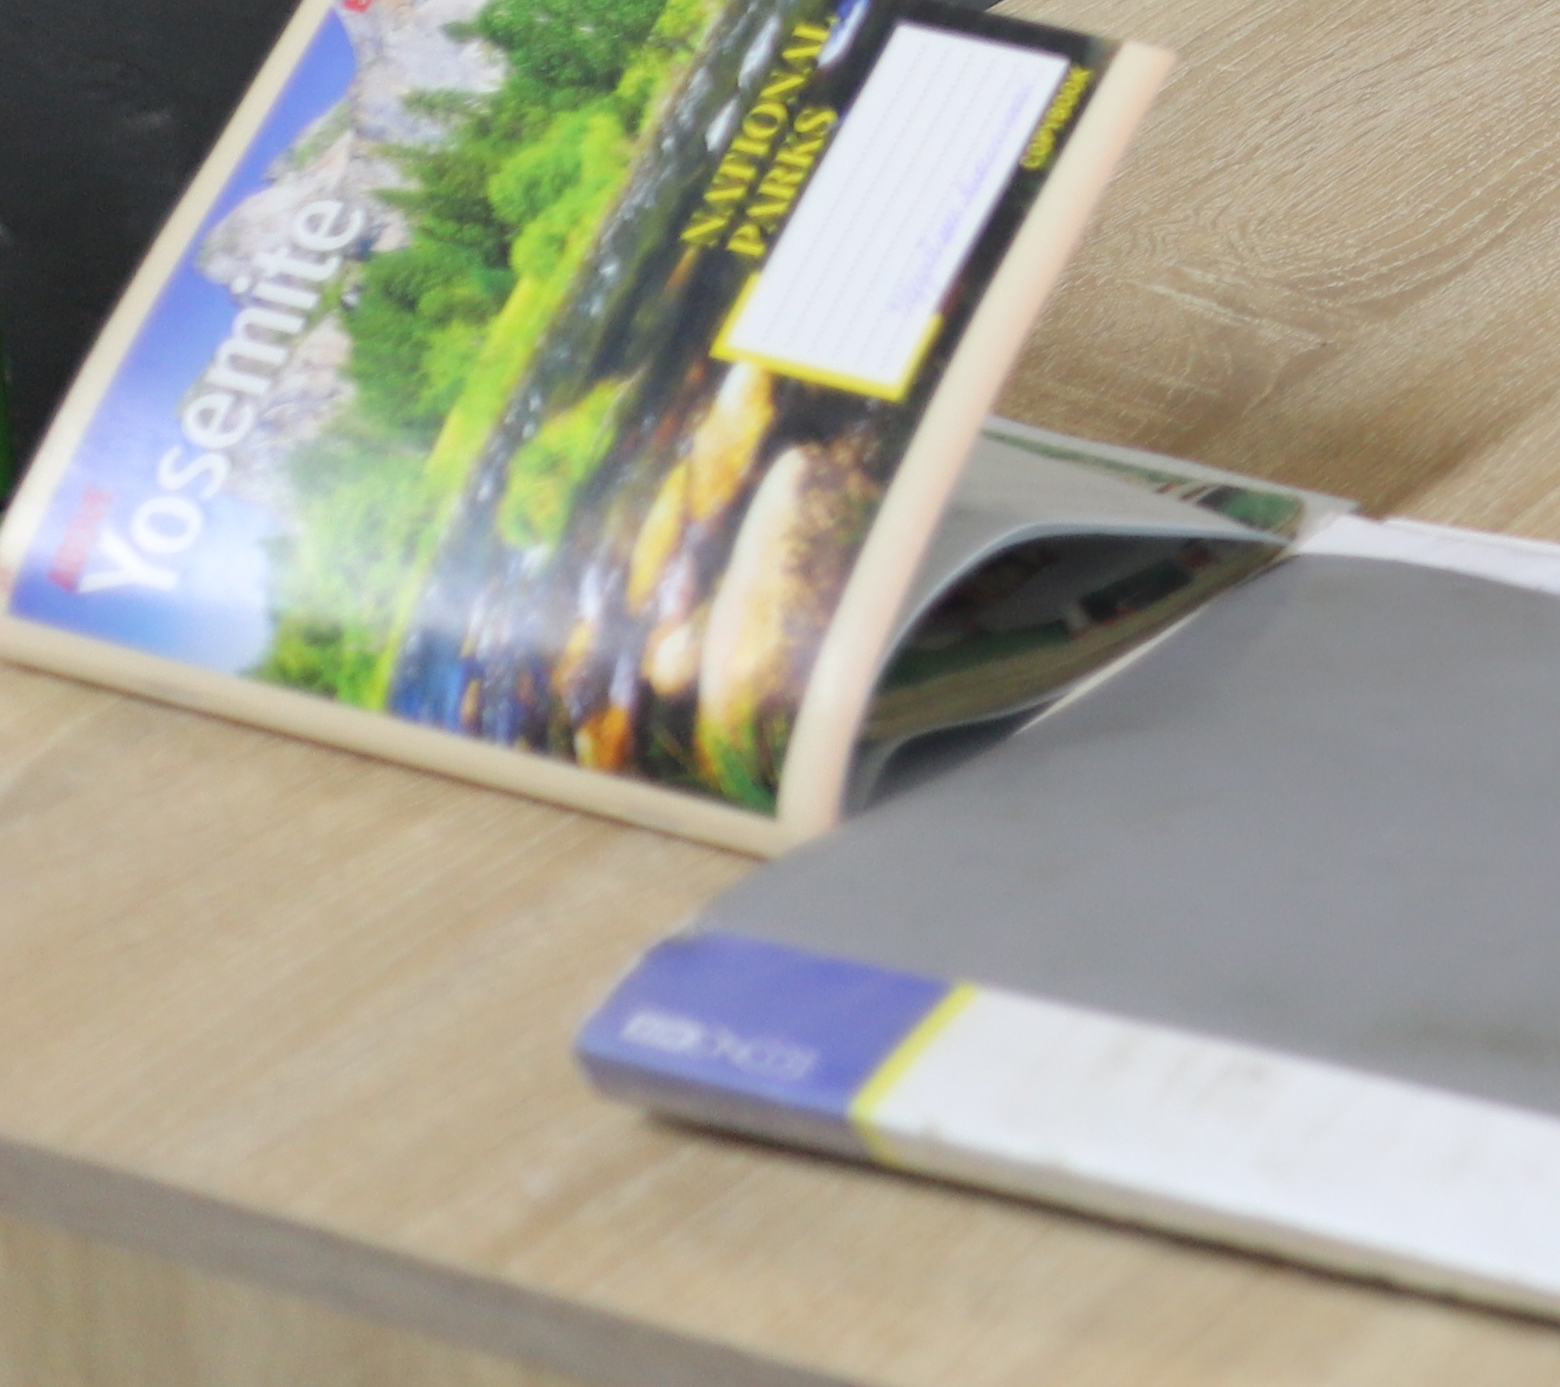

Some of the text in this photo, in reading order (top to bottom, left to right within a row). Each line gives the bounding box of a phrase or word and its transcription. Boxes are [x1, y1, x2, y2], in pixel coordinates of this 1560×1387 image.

[678, 16, 837, 250] NATIONAL
[724, 102, 839, 256] PARKS
[75, 192, 371, 597] Yosemite
